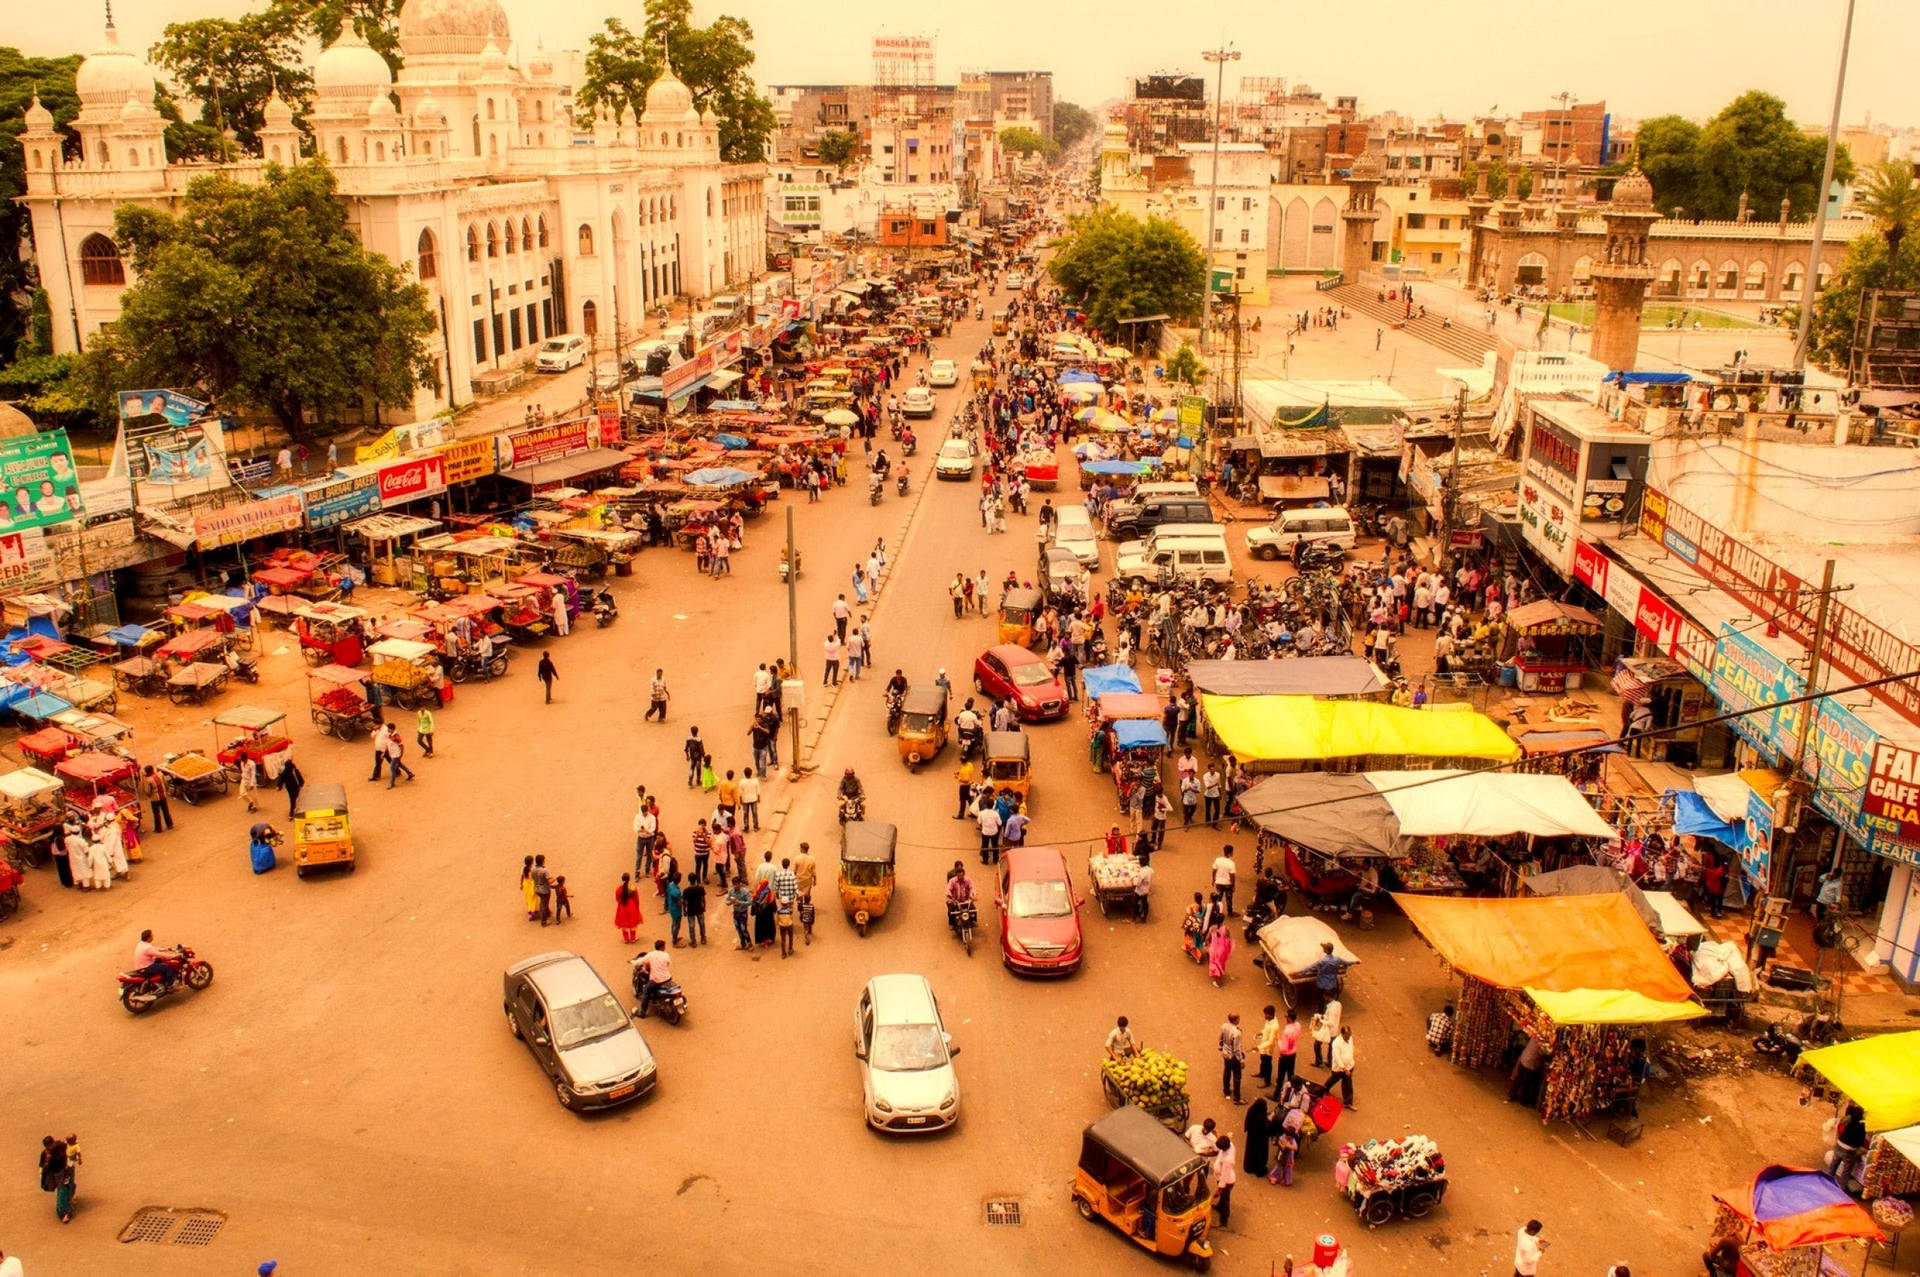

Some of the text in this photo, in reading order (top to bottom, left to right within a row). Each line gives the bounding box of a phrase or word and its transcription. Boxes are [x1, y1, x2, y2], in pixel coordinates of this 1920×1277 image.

[560, 423, 587, 437] HOTEL
[354, 473, 377, 490] BAKERY
[1730, 541, 1777, 593] BAKERY
[1715, 652, 1778, 715] PEARLS
[1869, 777, 1920, 807] CAFE
[1865, 814, 1898, 832] VEG
